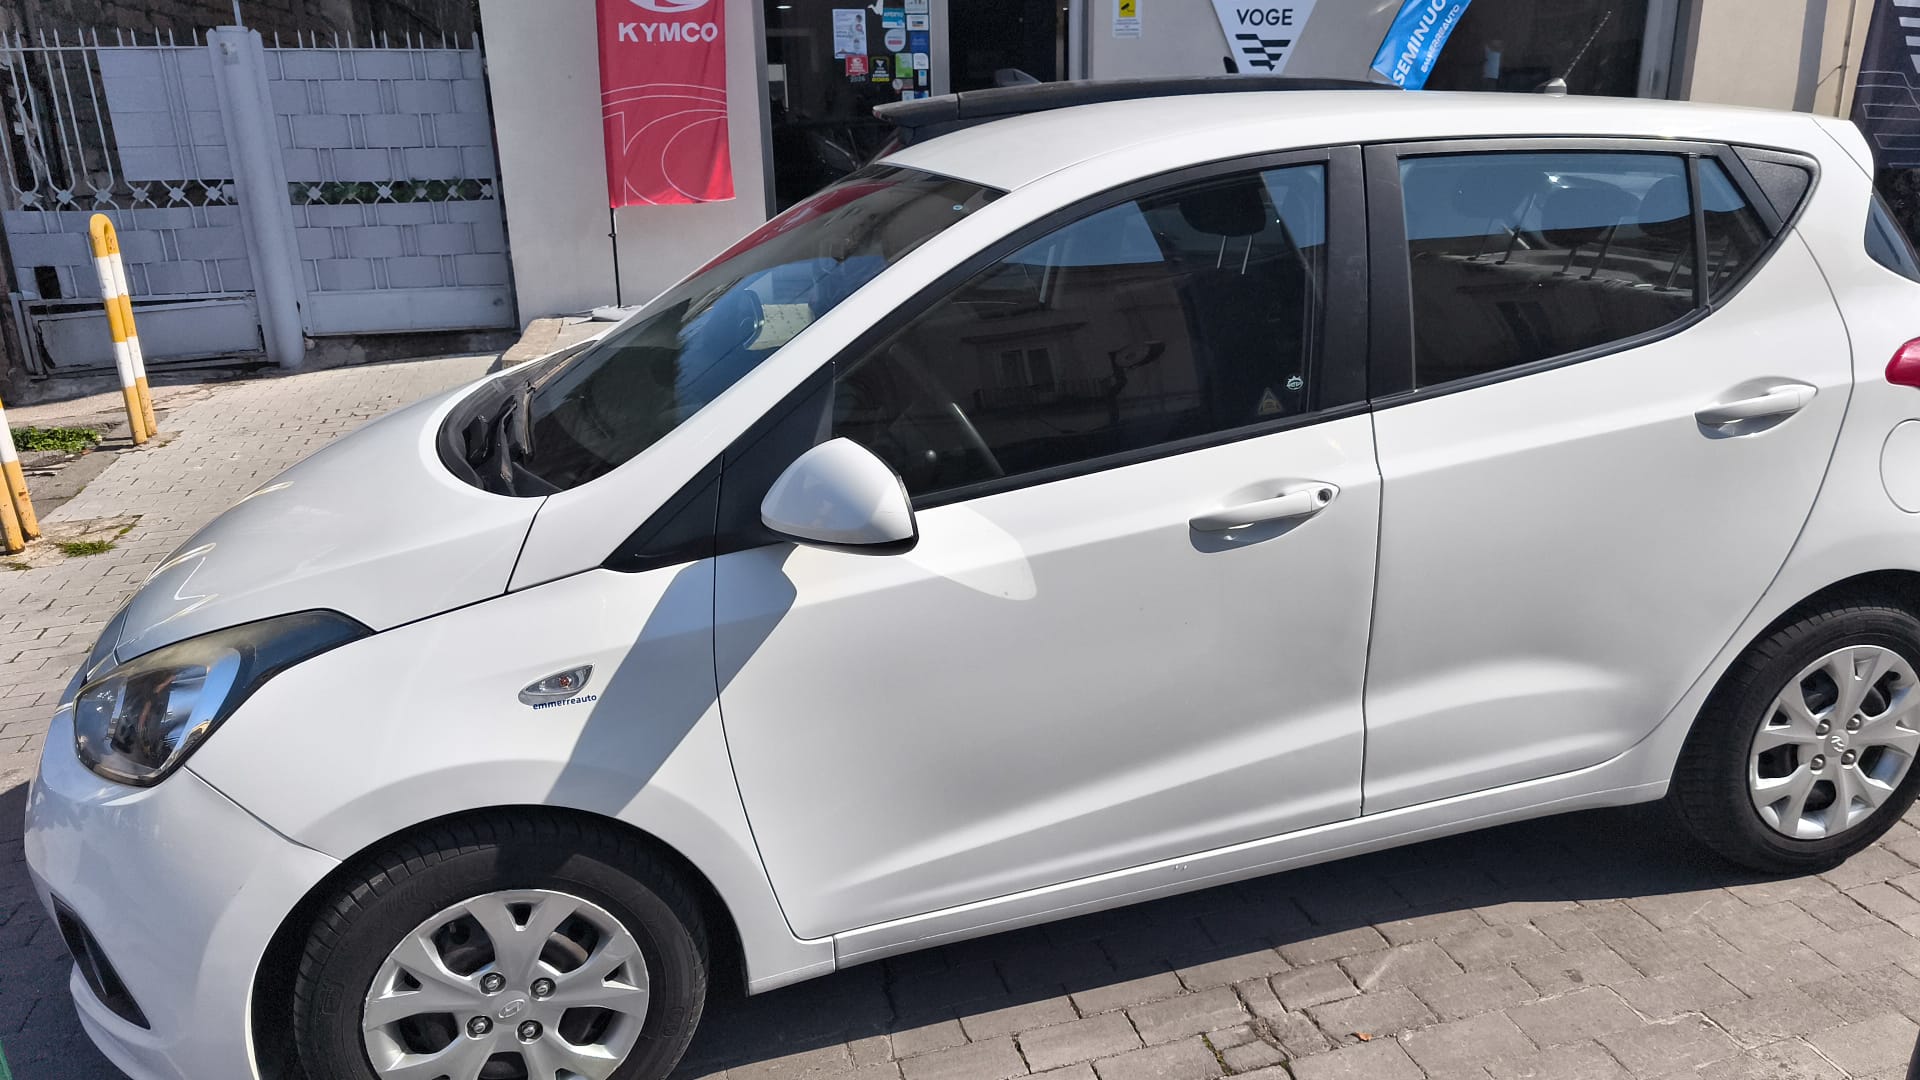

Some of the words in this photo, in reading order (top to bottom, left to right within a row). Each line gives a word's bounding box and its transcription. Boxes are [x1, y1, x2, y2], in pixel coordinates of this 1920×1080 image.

[1236, 8, 1293, 26] VOGE
[618, 22, 718, 42] KYMCO
[533, 694, 597, 710] emmerreauto
